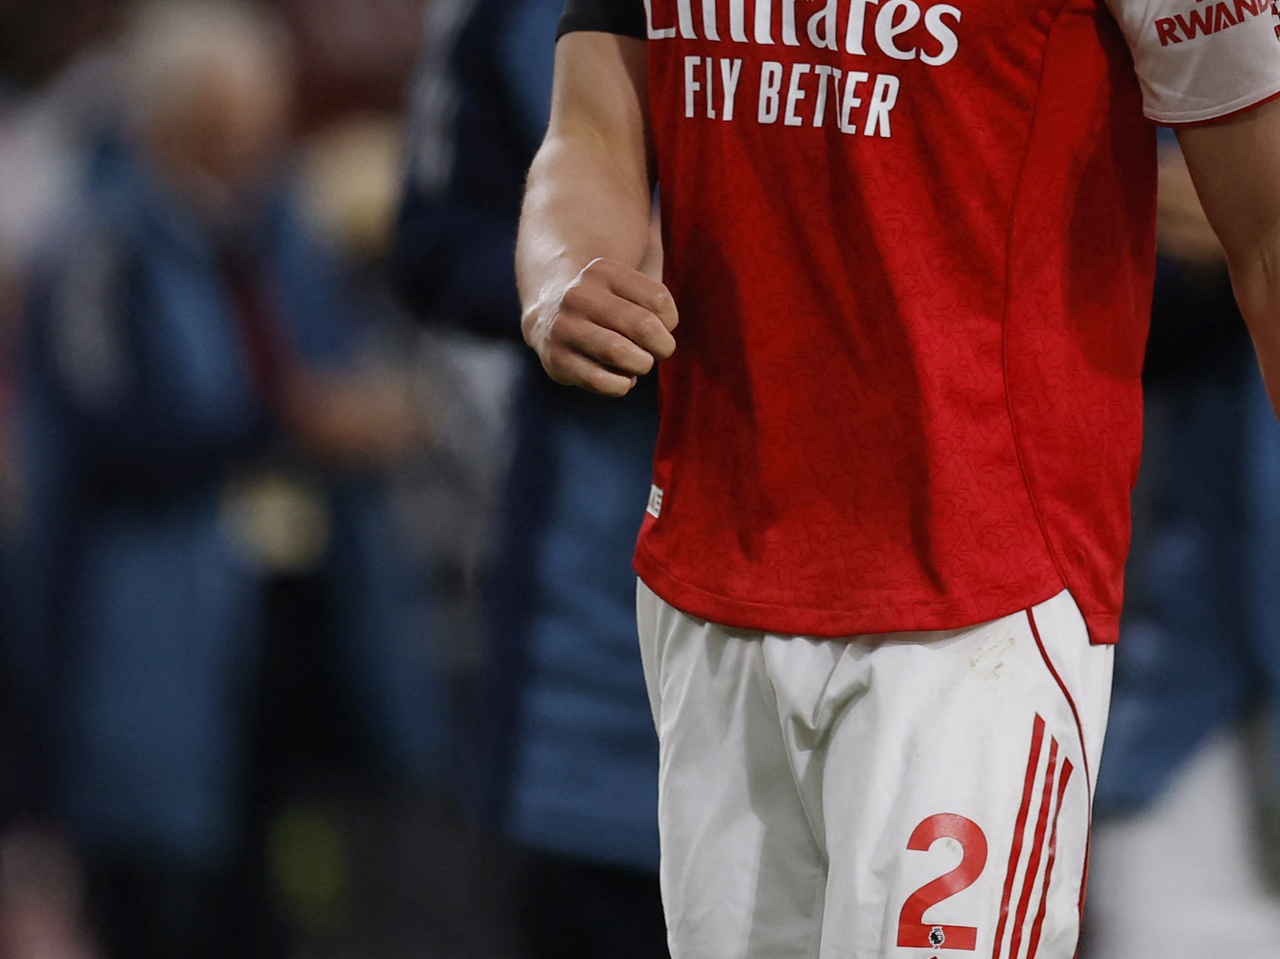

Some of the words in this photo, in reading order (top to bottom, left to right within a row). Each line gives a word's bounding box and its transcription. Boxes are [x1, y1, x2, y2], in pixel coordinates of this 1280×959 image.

[684, 55, 743, 121] FLY
[757, 60, 900, 138] BETTER
[896, 812, 989, 951] 2
